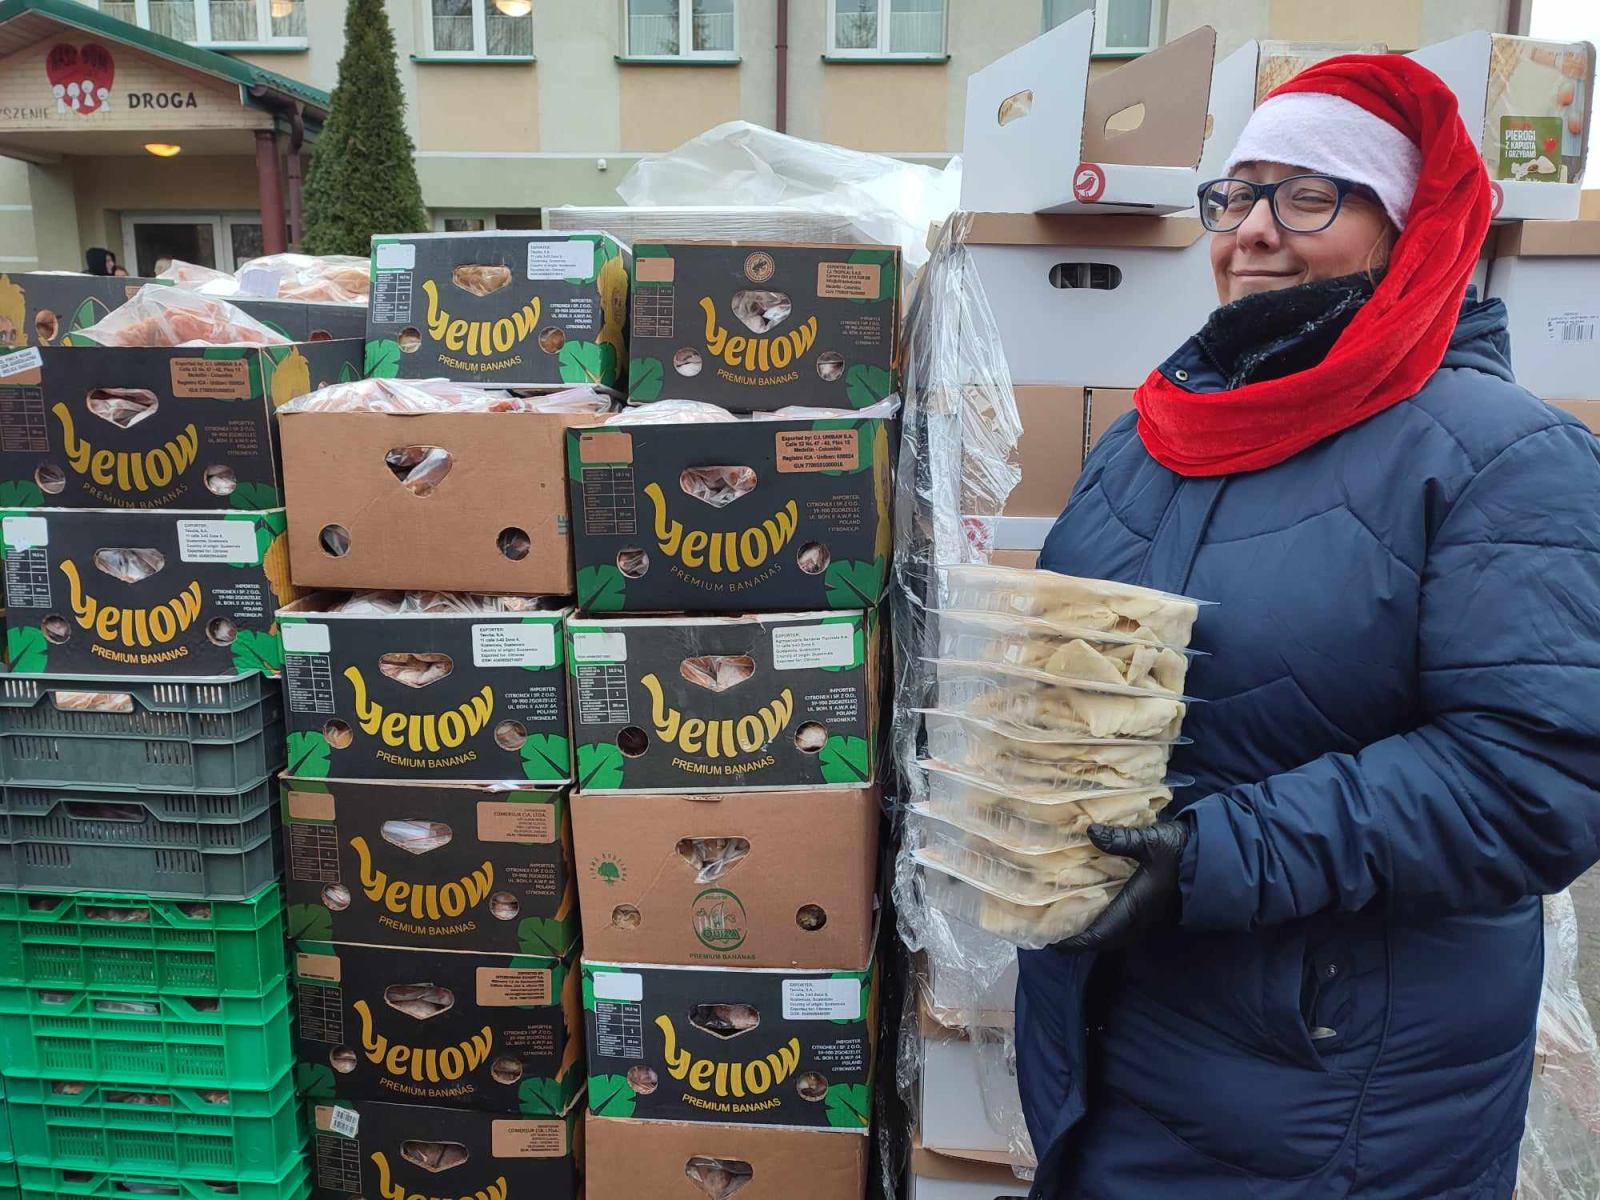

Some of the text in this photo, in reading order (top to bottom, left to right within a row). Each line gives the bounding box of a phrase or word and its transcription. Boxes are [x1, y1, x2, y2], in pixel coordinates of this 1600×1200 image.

[128, 92, 198, 109] DROGA
[1505, 130, 1536, 141] PIEROGI
[438, 354, 522, 372] PREMIUM BANANAS
[717, 368, 799, 386] PREMIUM BANANAS
[82, 482, 189, 509] PREMIUM BANANAS
[670, 563, 782, 592] PREMIUM BANANAS
[91, 644, 189, 664] PREMIUM BANANAS
[376, 750, 477, 769] PREMIUM BANANAS
[671, 755, 775, 776] PREMIUM BANANAS
[378, 915, 476, 936] PREMIUM BANANAS
[379, 1077, 475, 1098] PREMIUM BANANAS
[682, 1093, 782, 1114] PREMIUM BANANAS
